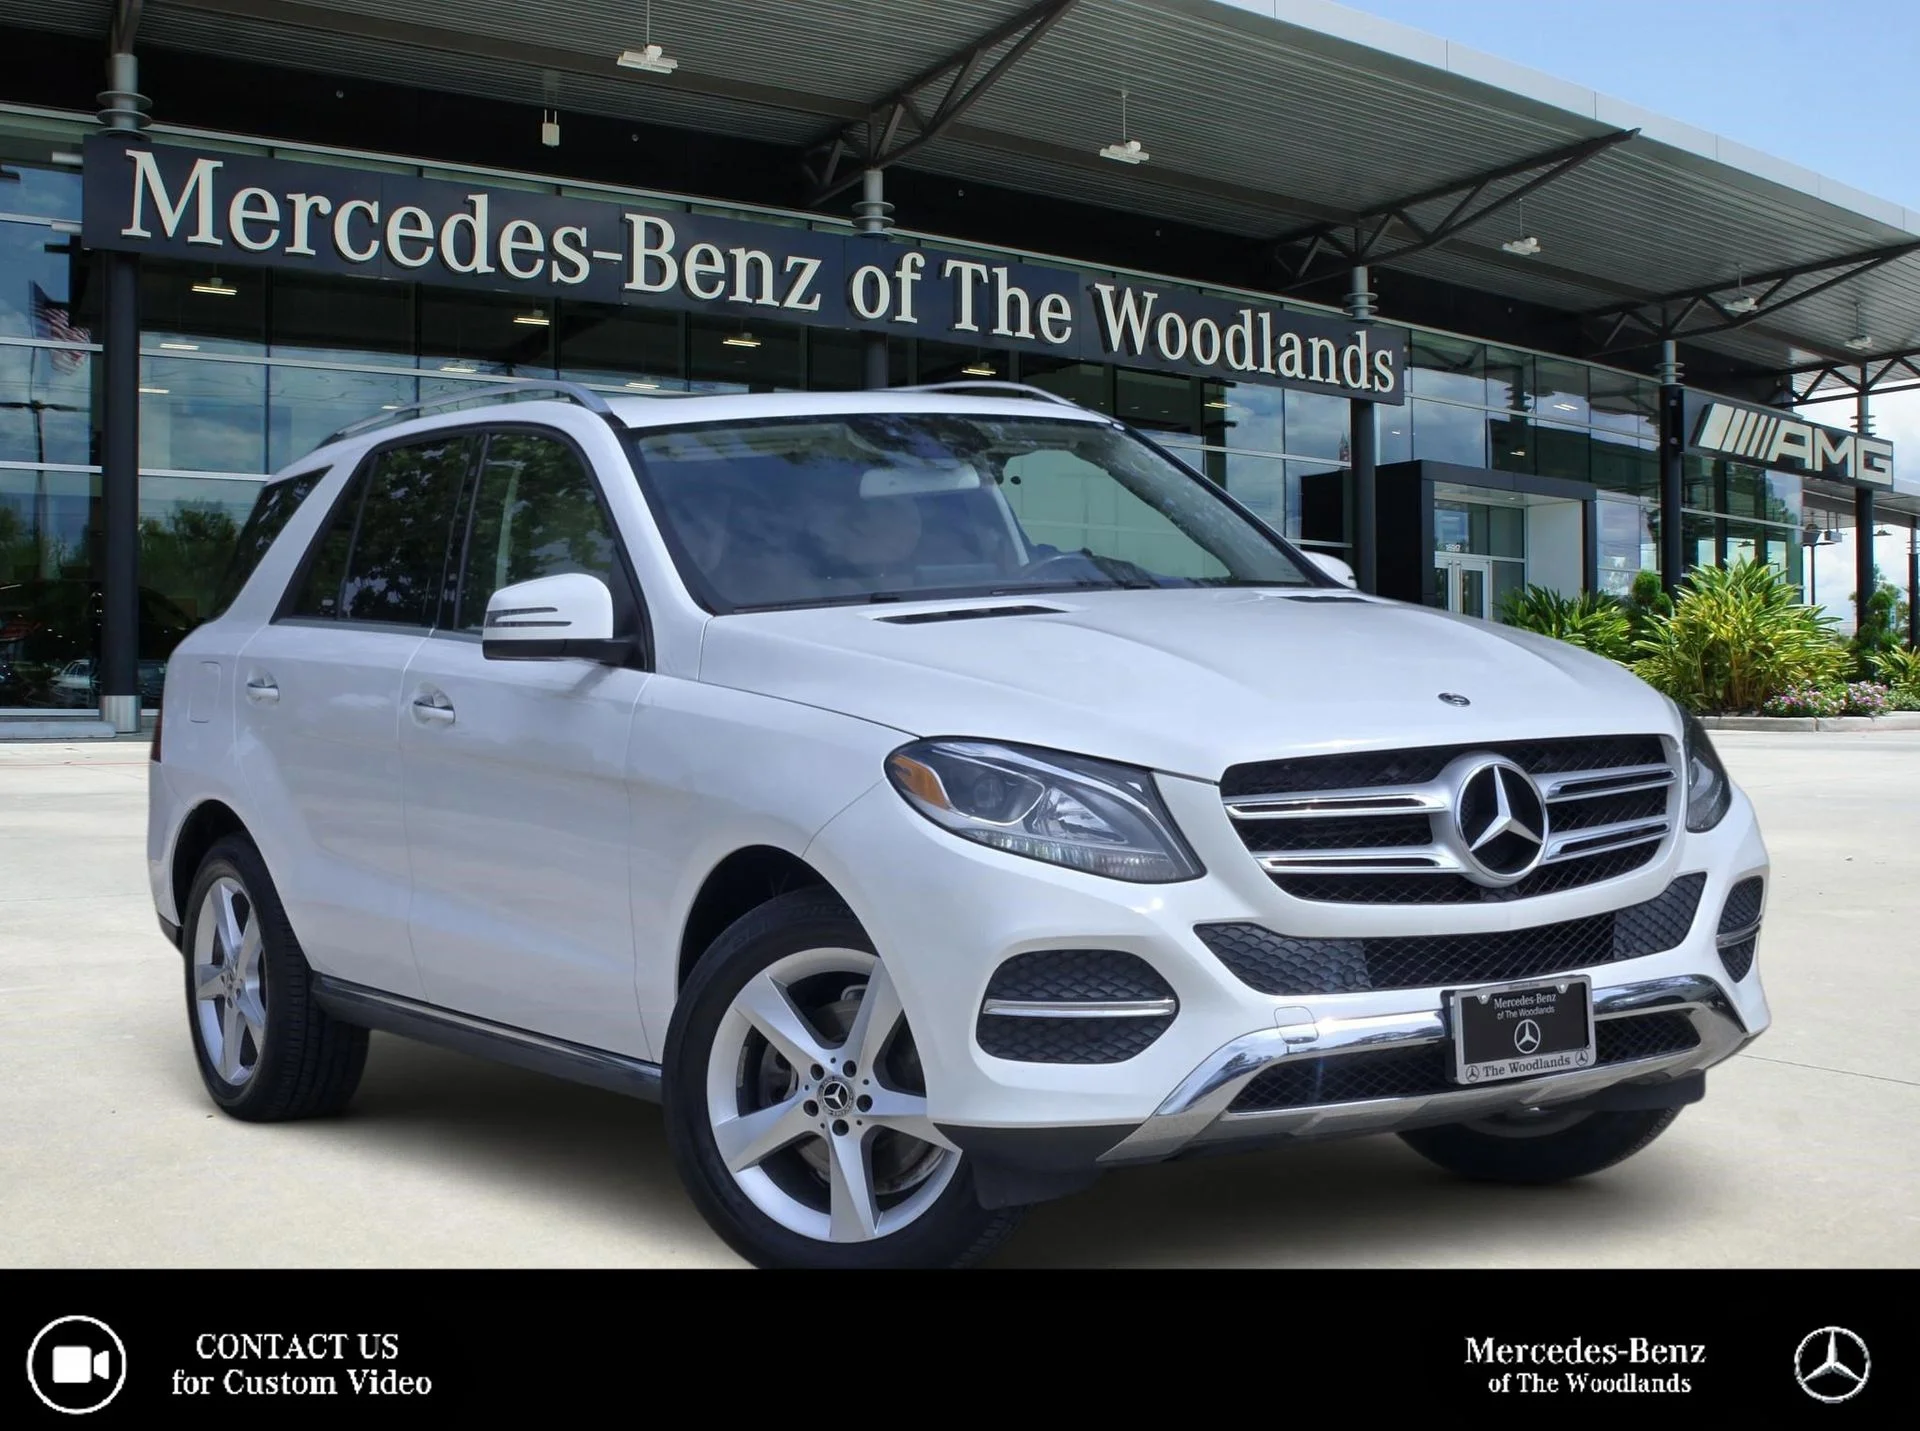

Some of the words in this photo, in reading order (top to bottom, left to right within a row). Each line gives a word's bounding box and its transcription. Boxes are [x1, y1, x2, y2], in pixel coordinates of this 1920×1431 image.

[121, 149, 822, 312] Mercedes-Benz
[852, 252, 925, 324] of
[945, 259, 1073, 345] The
[1095, 281, 1396, 394] Woodlands
[1494, 993, 1556, 1010] Mercedes-Benz
[1497, 1011, 1504, 1020] of
[1505, 1010, 1518, 1018] The
[1519, 1005, 1555, 1016] Woodlands
[1483, 1064, 1505, 1077] The
[1508, 1056, 1571, 1073] Woodlands
